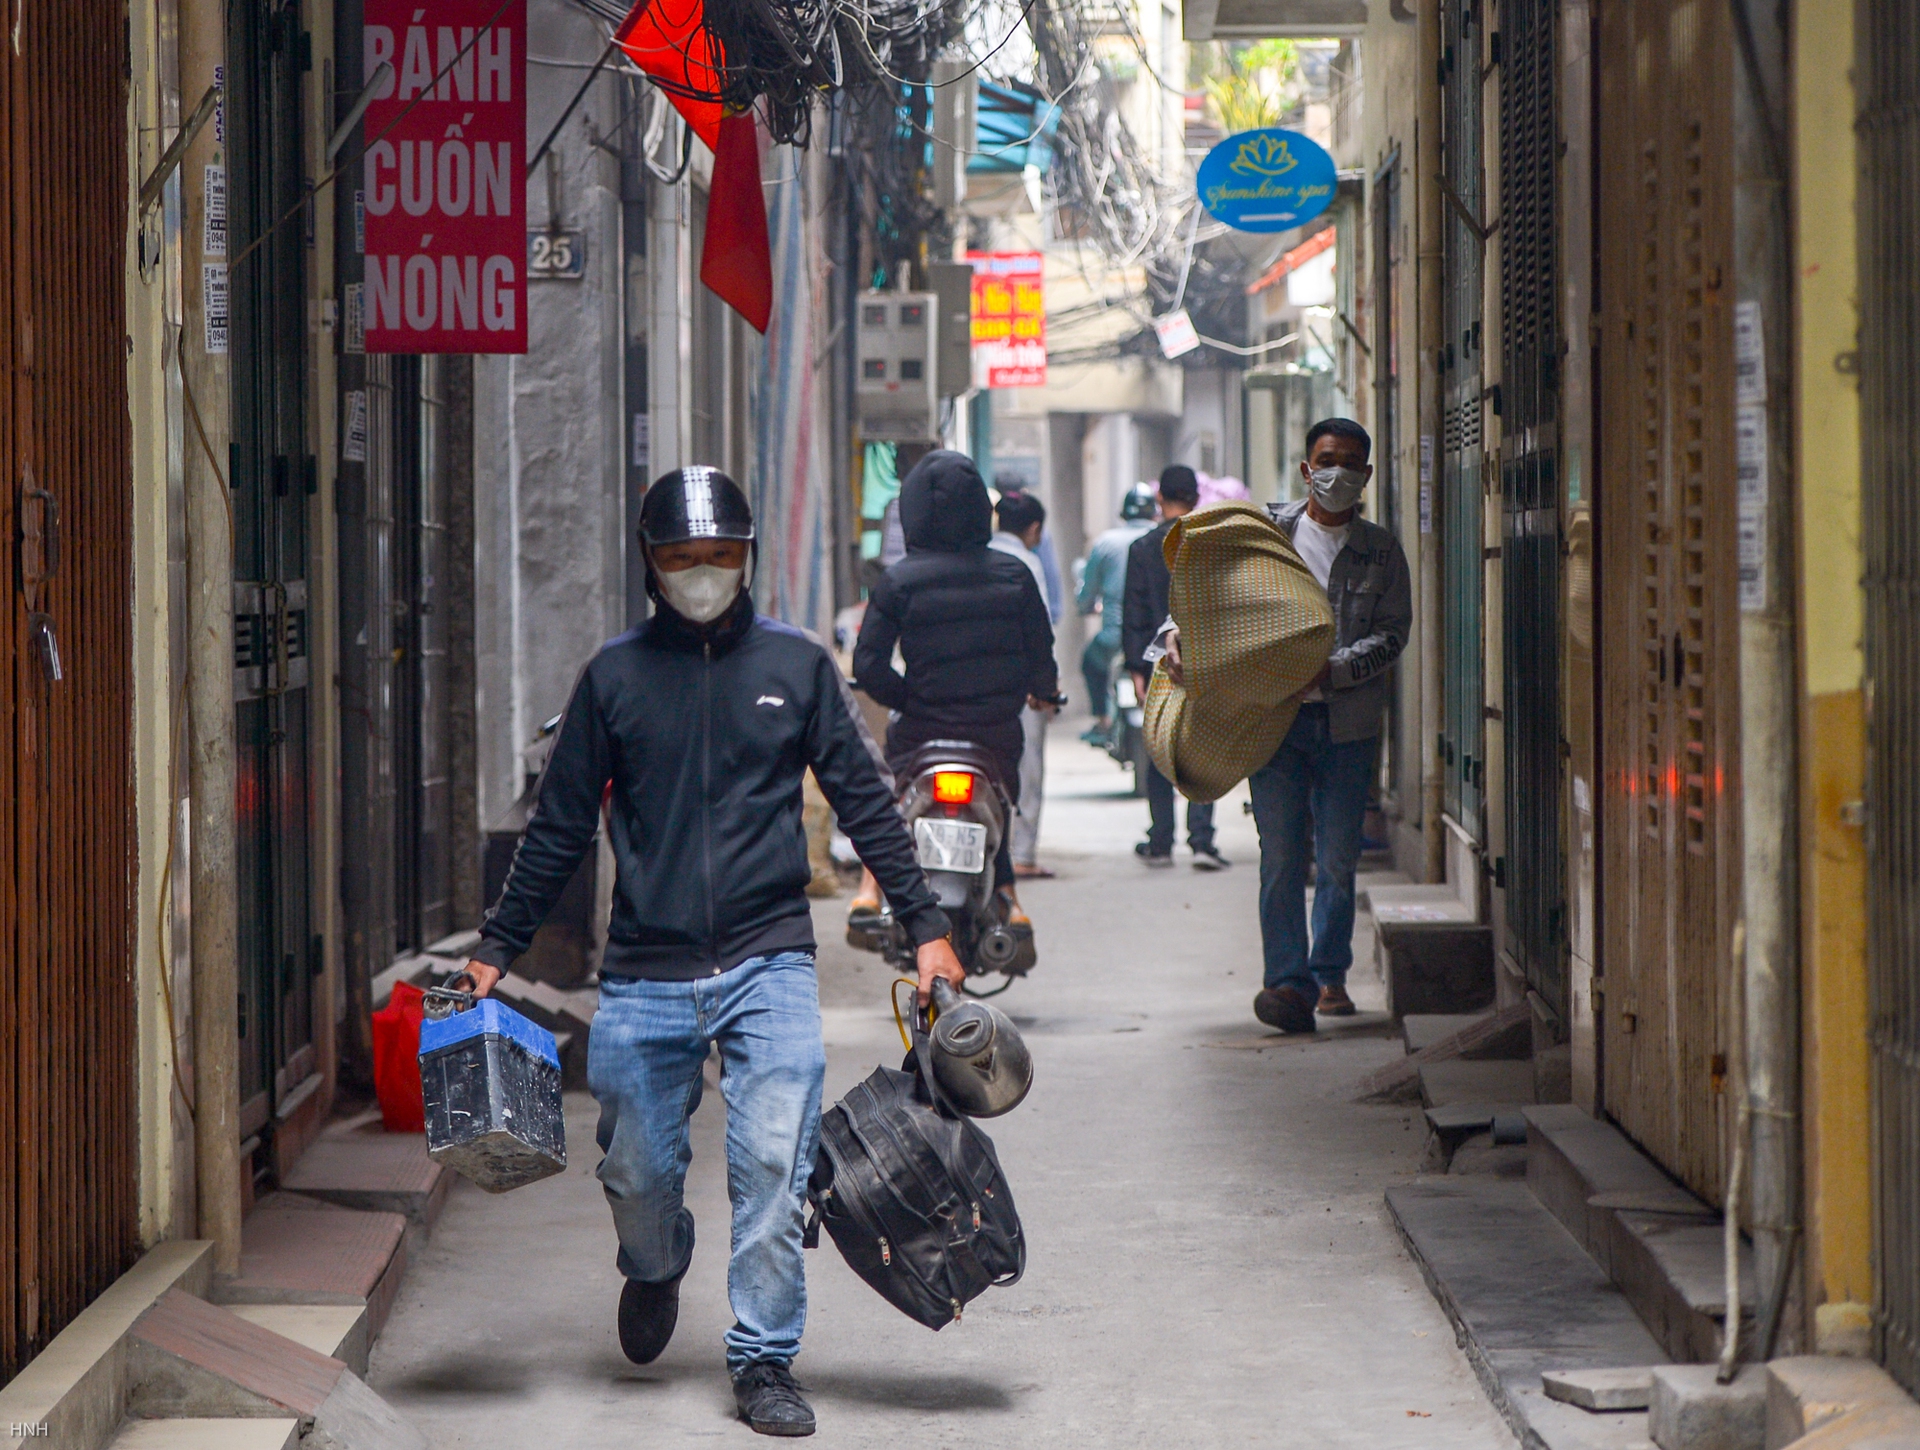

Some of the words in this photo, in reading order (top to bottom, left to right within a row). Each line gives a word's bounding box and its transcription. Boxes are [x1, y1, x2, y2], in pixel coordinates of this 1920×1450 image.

[363, 9, 511, 101] BÁNH
[364, 113, 511, 217] CUỐN
[363, 234, 515, 331] NÓNG
[532, 236, 572, 269] 25
